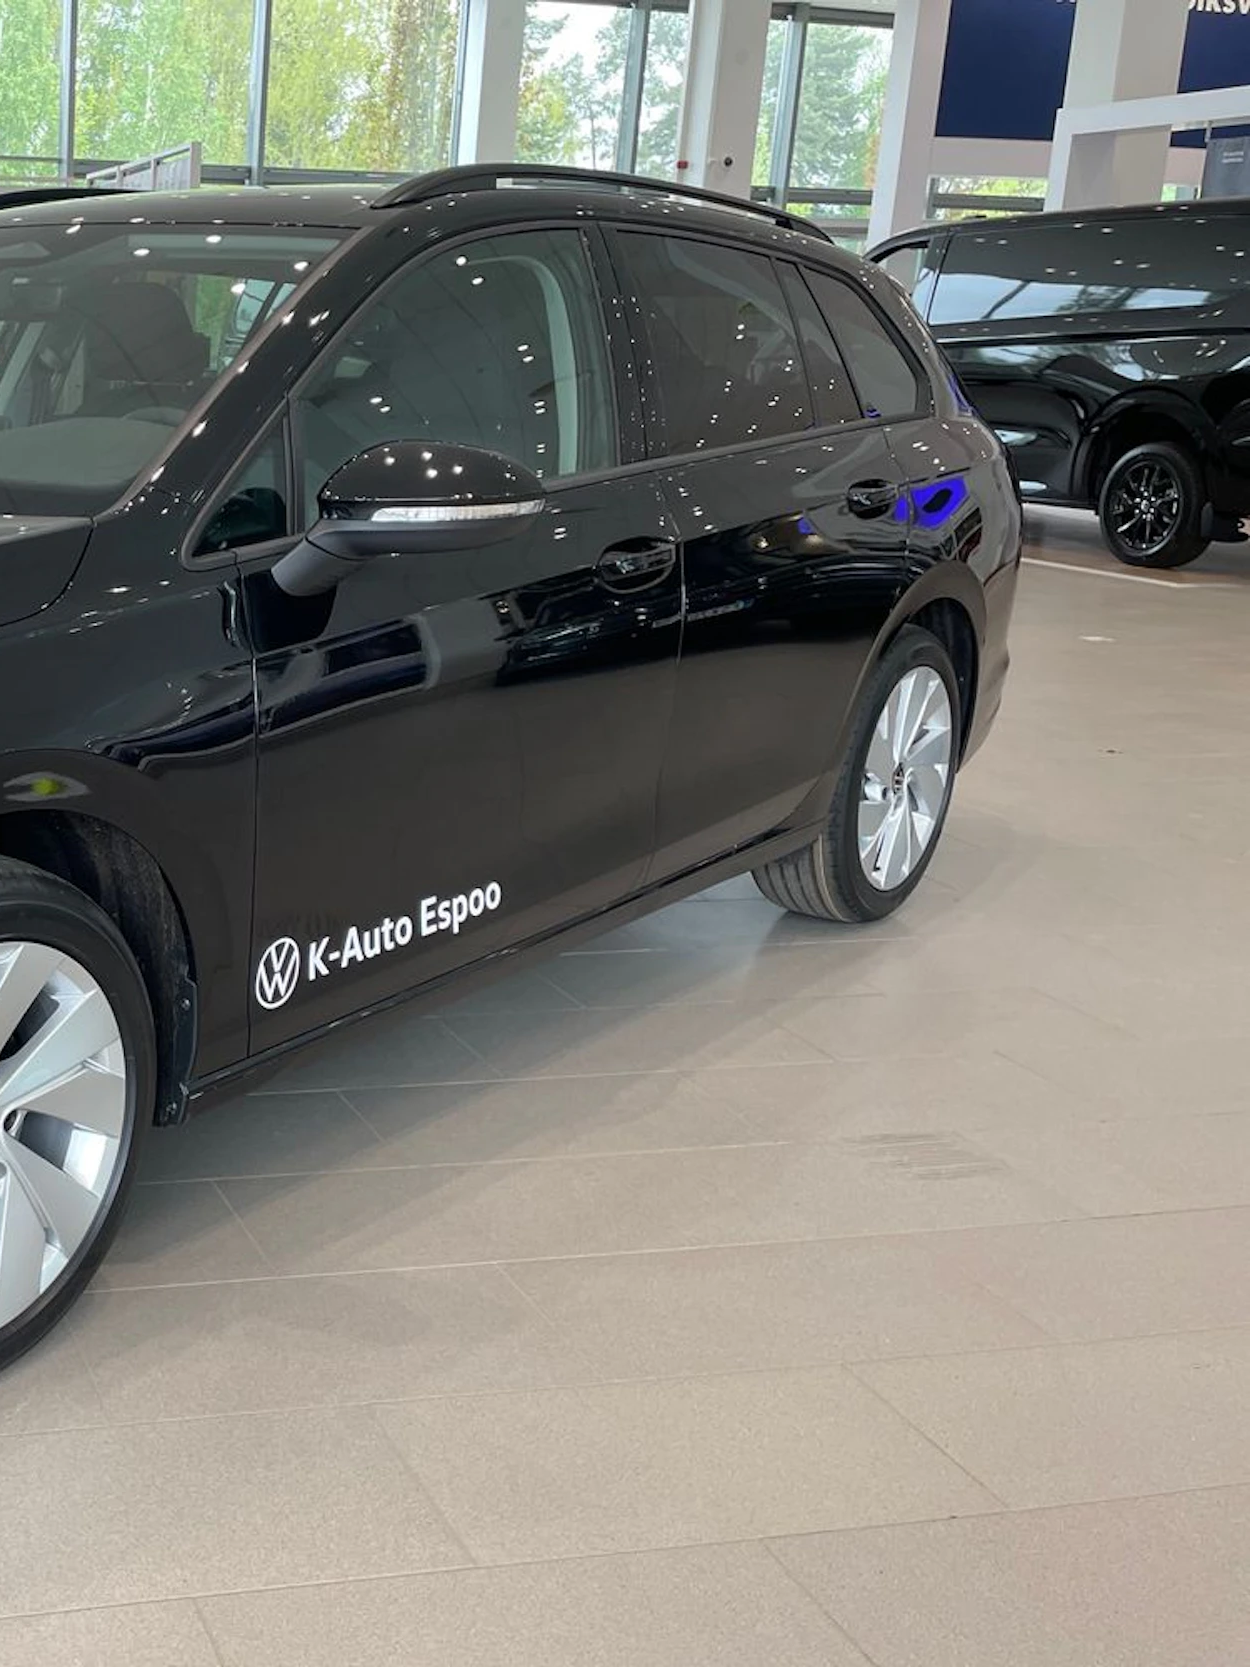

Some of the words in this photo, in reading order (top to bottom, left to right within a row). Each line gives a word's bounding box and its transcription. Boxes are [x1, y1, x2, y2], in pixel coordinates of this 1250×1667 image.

[255, 937, 300, 1010] VW
[307, 915, 414, 982] K-Auto
[419, 881, 502, 936] Espoo
